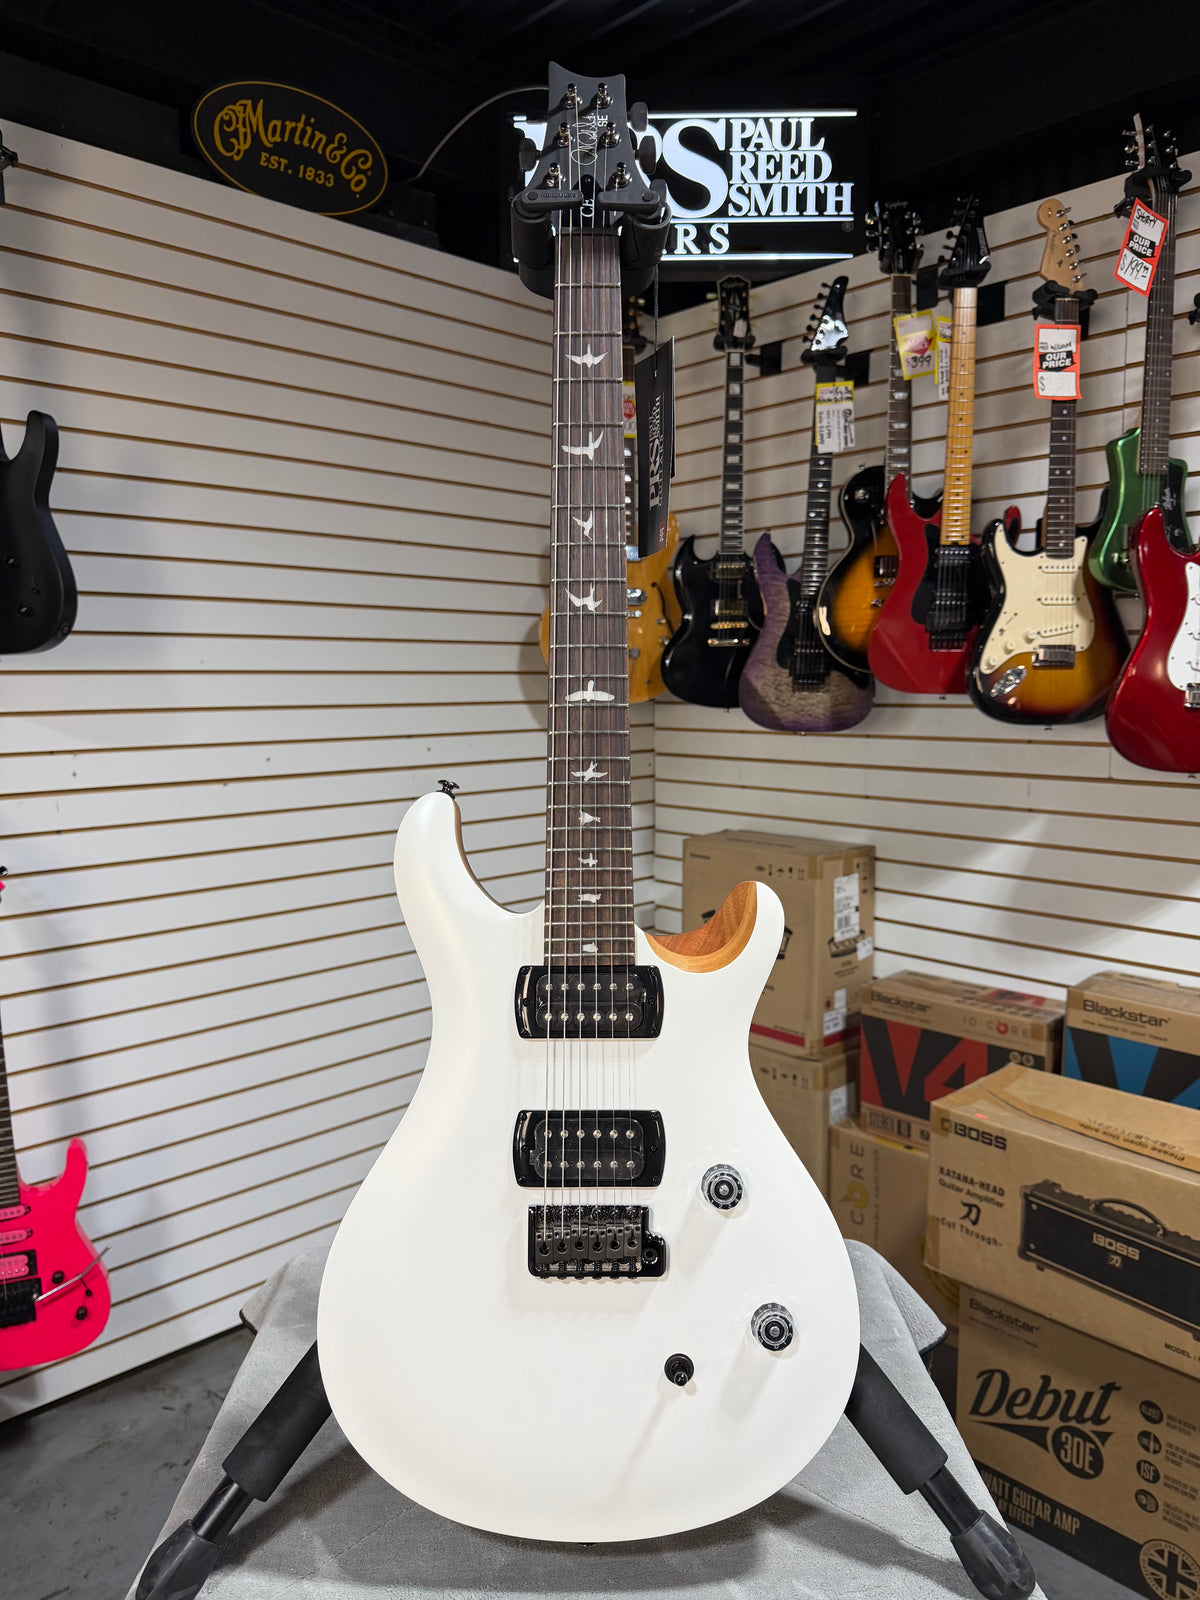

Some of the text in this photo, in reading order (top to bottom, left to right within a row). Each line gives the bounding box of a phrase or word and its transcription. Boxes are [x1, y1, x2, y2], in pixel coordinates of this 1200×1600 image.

[729, 118, 825, 151] PAUL
[259, 152, 335, 187] EST. 1833
[729, 150, 832, 184] REED
[728, 183, 855, 216] SMITH
[1128, 242, 1153, 257] PRICE
[1133, 234, 1151, 248] OUR
[1042, 358, 1071, 369] PRICE
[1046, 352, 1067, 361] OUR
[649, 438, 660, 511] PRS
[870, 990, 933, 1013] Blackstar
[1082, 999, 1169, 1027] Blackstar
[954, 1121, 1007, 1151] BOSS
[938, 1165, 1005, 1197] KATANA-HEAD
[938, 1177, 1005, 1209] Guitar Amplifier
[1092, 1231, 1140, 1261] BOSS
[969, 1297, 1039, 1333] Blackstar
[1164, 1342, 1192, 1359] MODEL
[969, 1368, 1122, 1426] Debut
[1060, 1430, 1096, 1475] 30E
[1140, 1461, 1156, 1481] ISF
[1009, 1503, 1036, 1529] EFFECT
[1011, 1487, 1052, 1523] GUITAR
[1038, 1509, 1081, 1536] AMP
